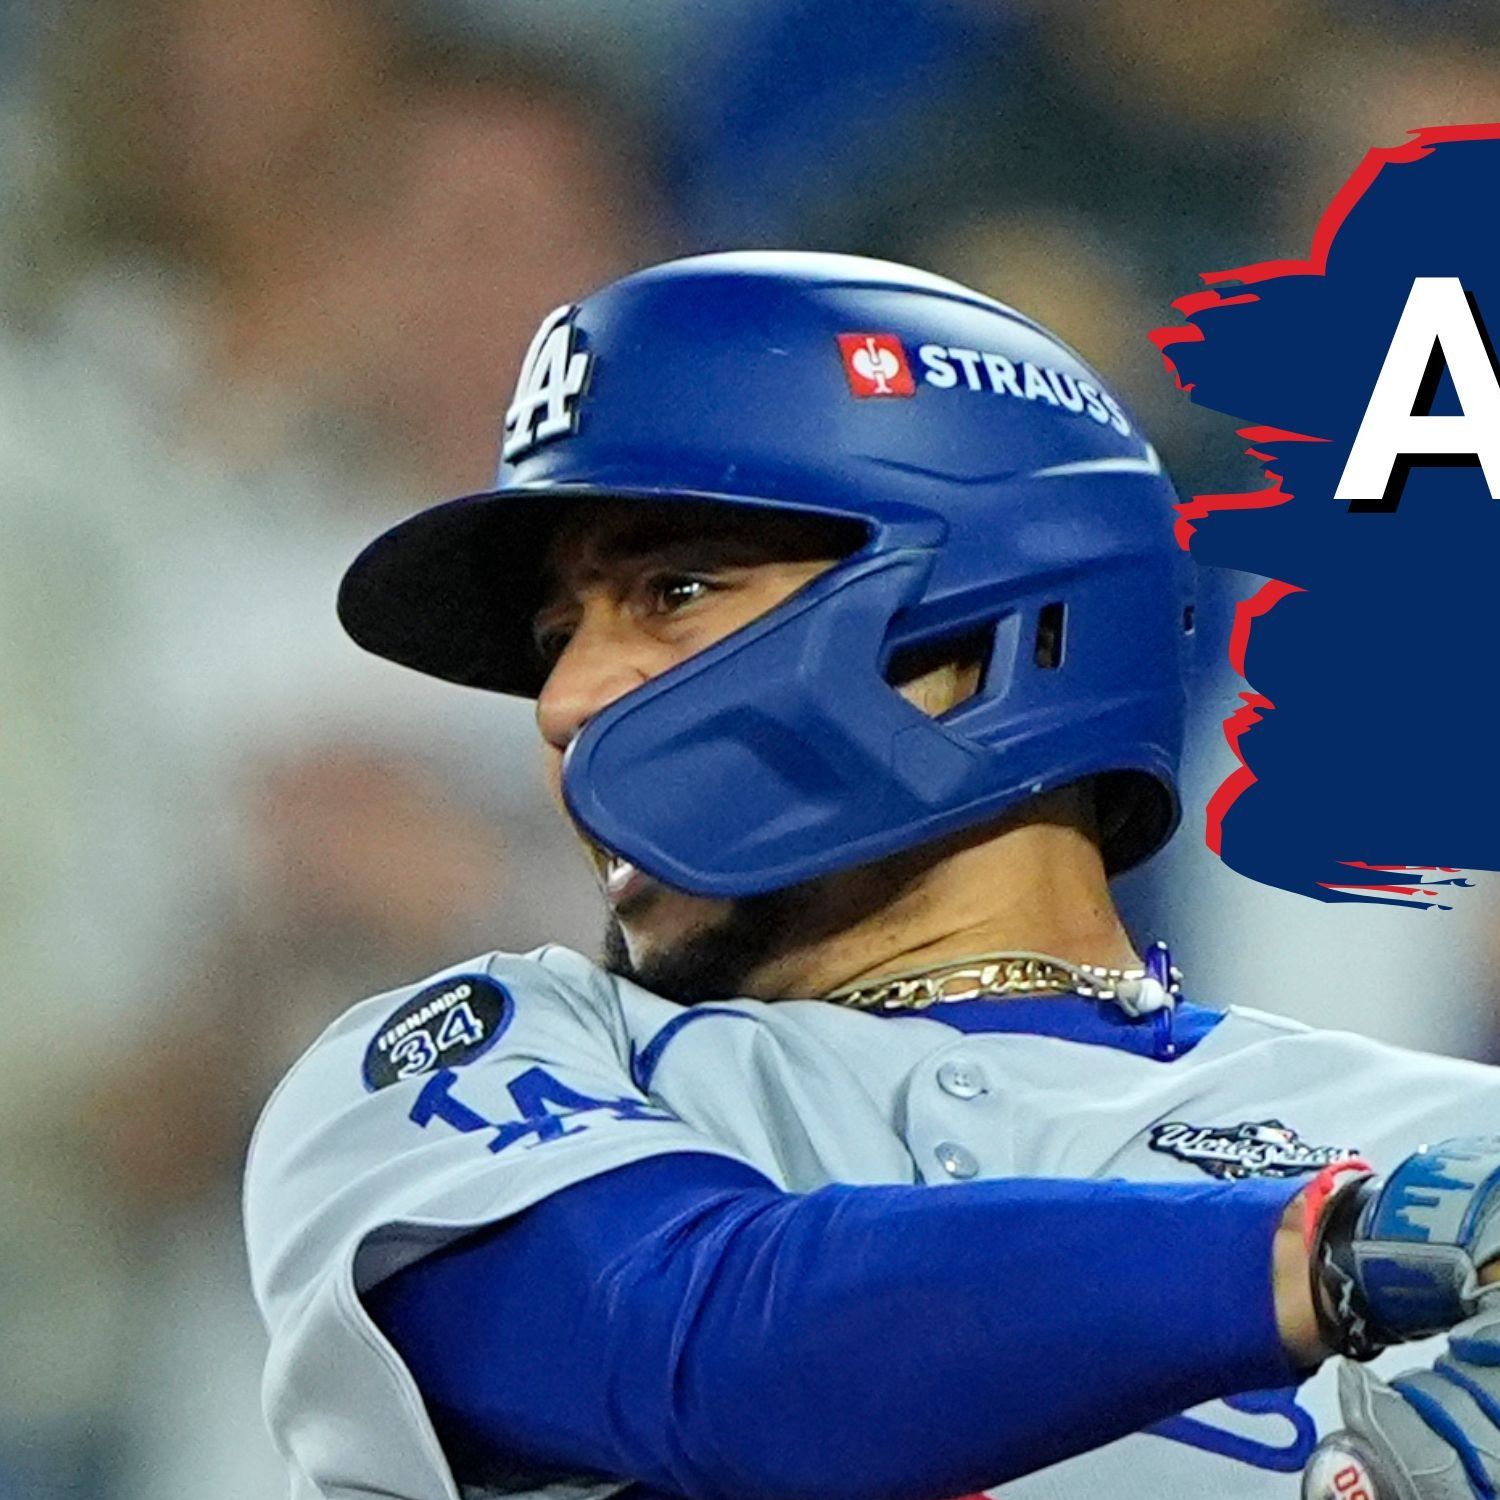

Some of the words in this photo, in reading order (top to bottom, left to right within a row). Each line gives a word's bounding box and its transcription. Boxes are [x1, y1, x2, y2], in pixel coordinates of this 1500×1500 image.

[503, 304, 590, 460] LA
[919, 343, 1131, 437] STRAUSS
[377, 983, 473, 1052] FERNANDO
[388, 1001, 485, 1080] 34
